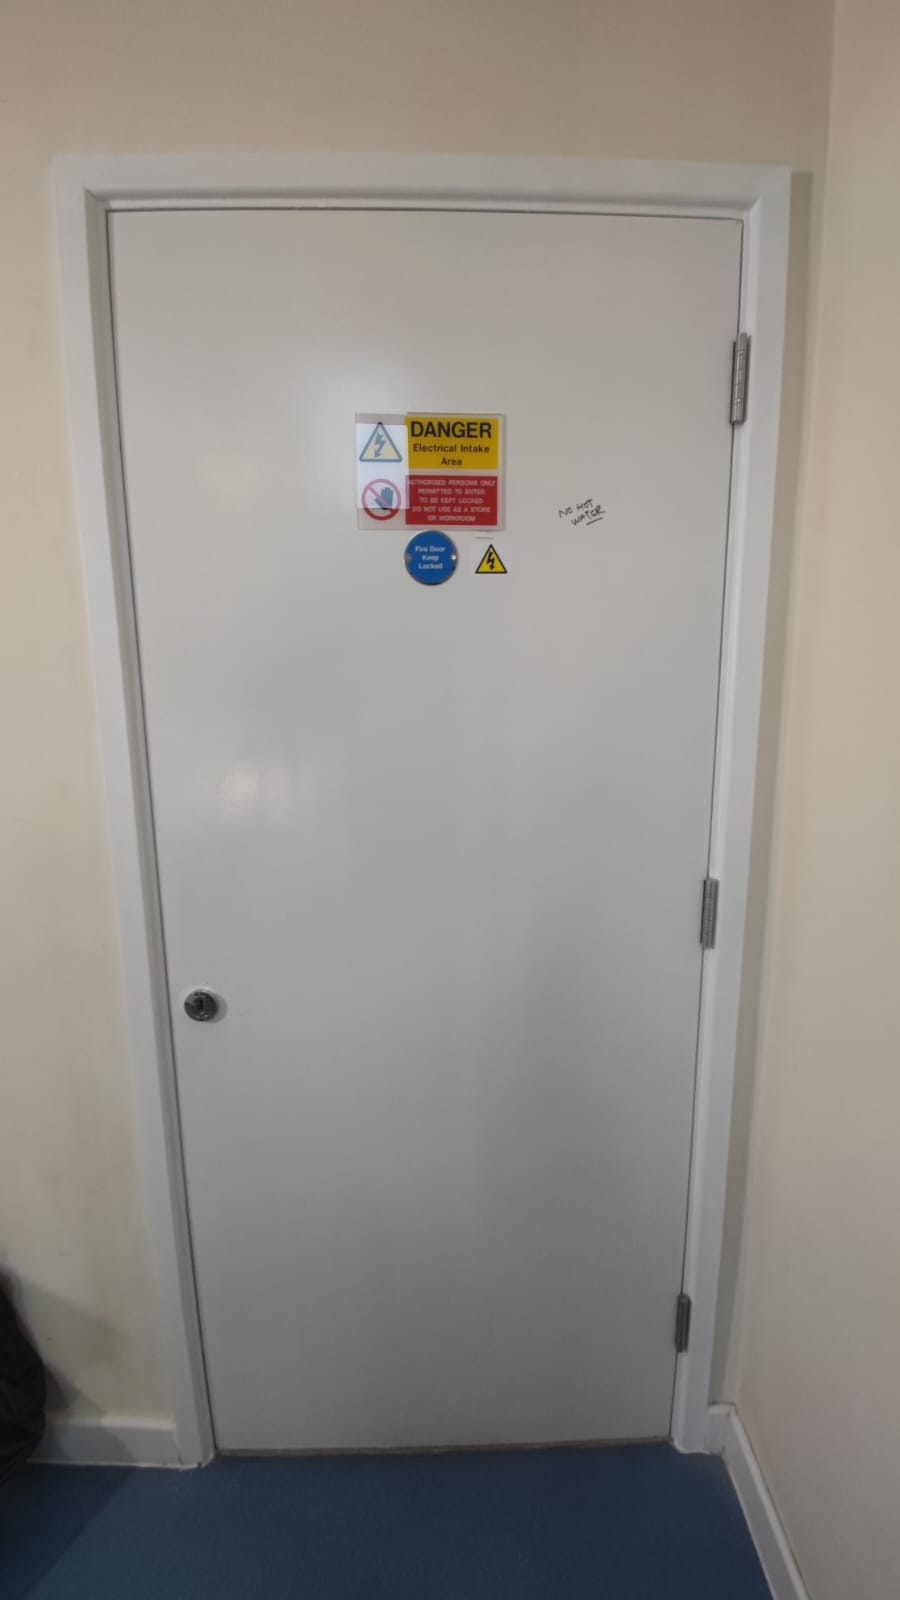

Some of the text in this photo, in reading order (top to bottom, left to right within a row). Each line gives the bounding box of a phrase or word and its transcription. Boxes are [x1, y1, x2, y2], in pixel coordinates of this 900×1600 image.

[410, 421, 492, 438] DANGER
[413, 444, 489, 453] Electrical Intake
[441, 457, 462, 466] Area
[558, 498, 593, 518] NO HOT
